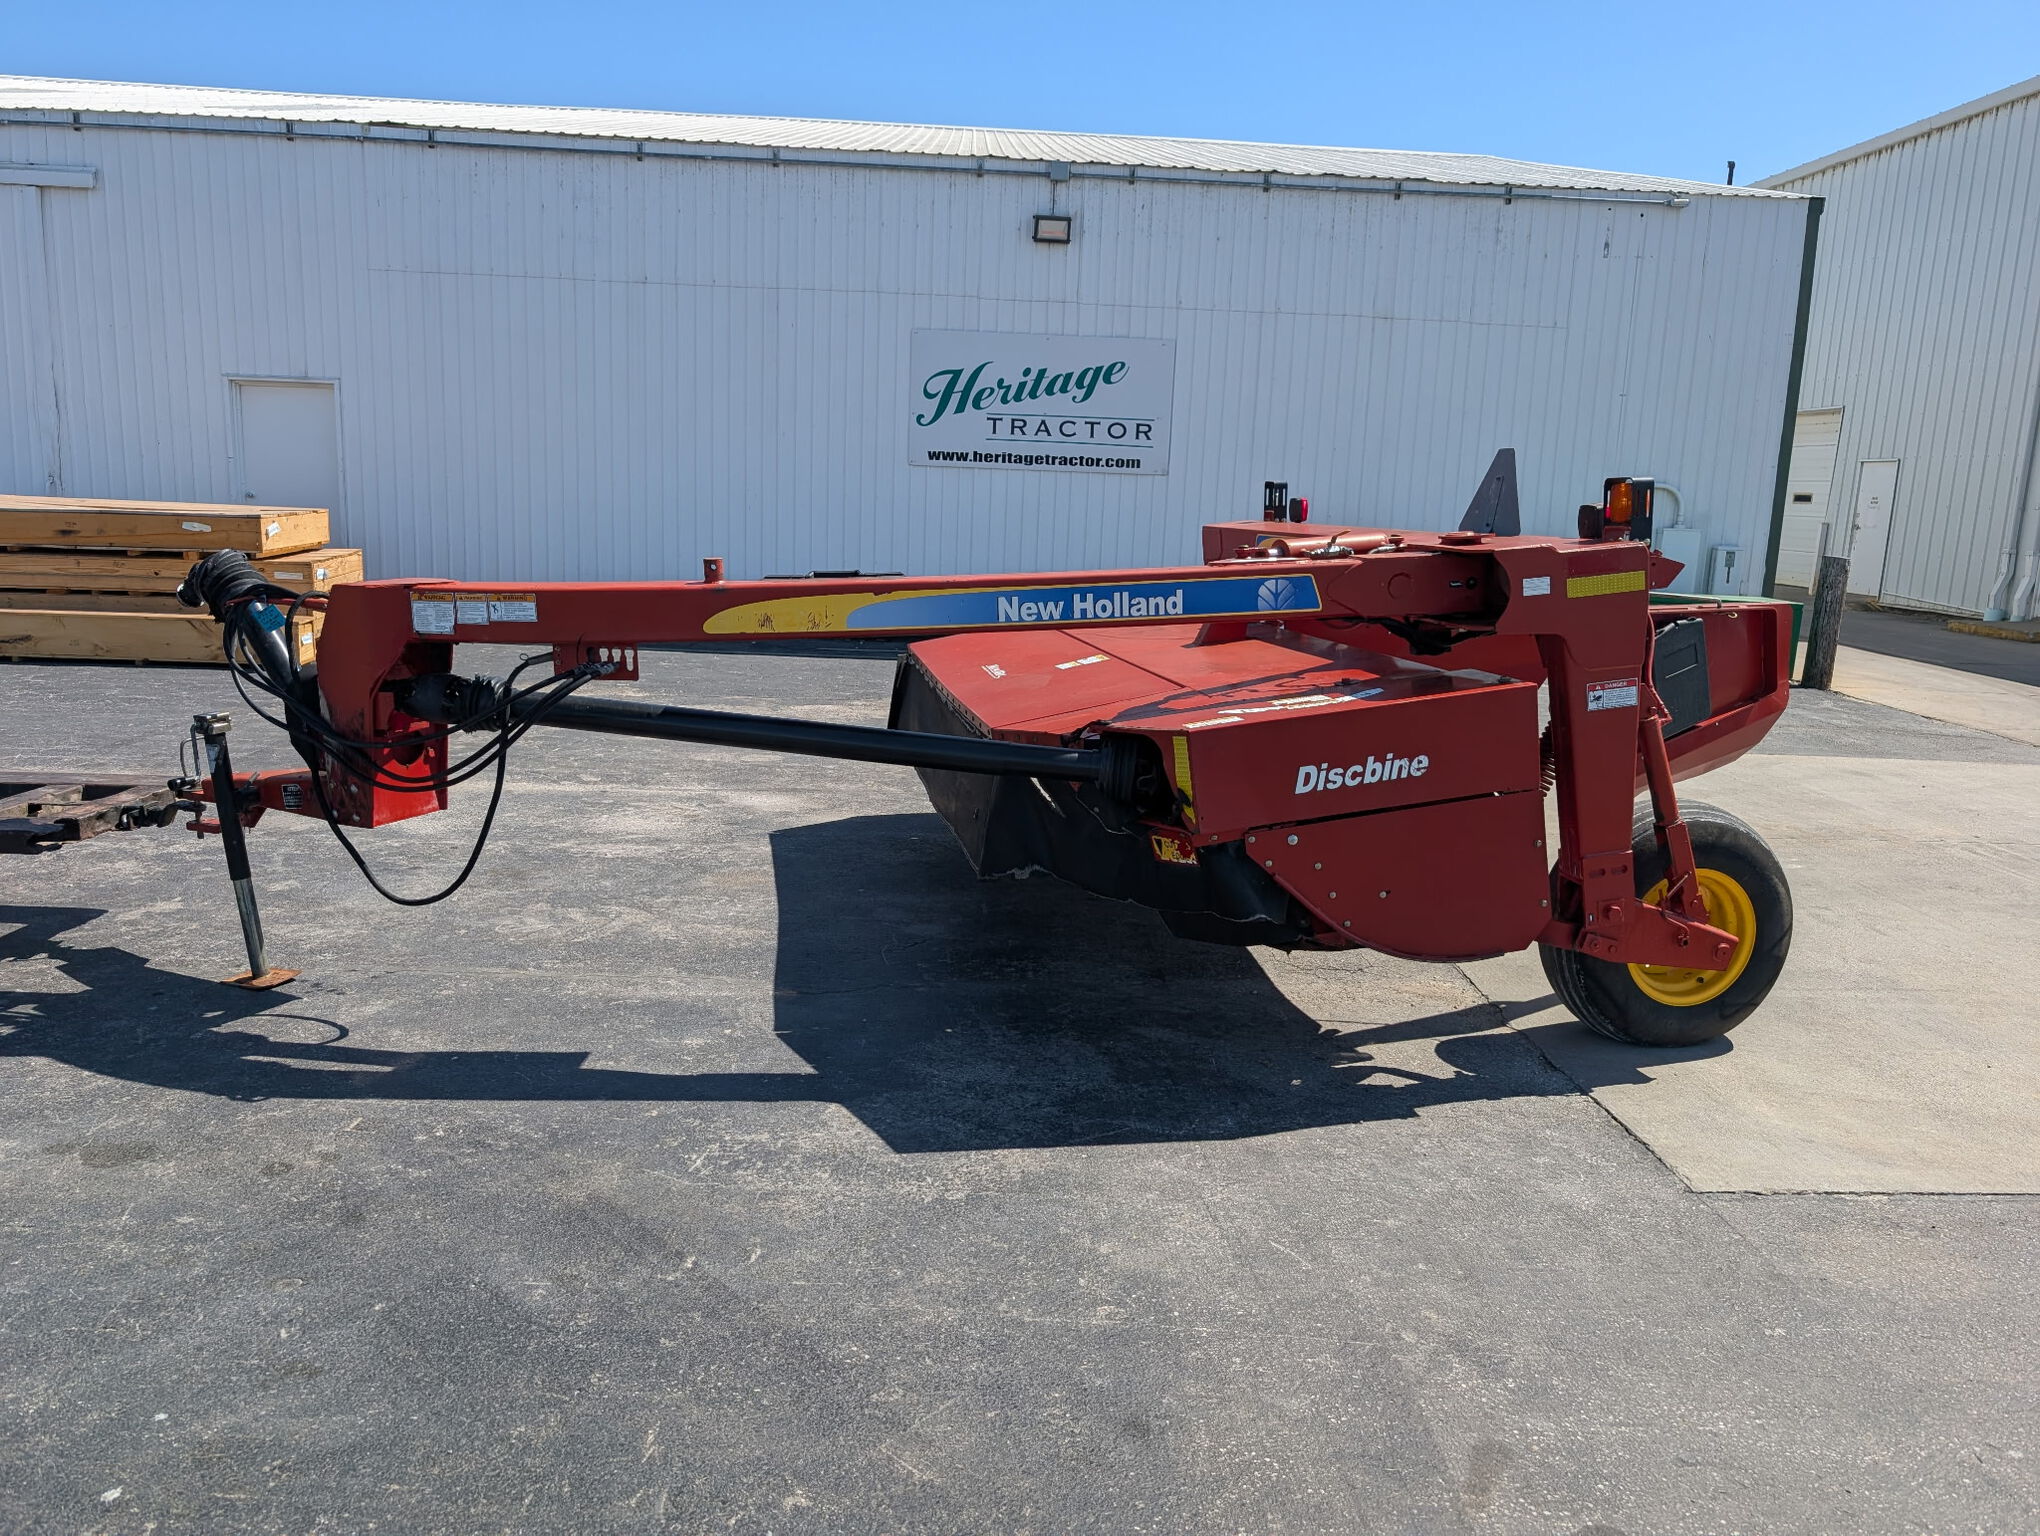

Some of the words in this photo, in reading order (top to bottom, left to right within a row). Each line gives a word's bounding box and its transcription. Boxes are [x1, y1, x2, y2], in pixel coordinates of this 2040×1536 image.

[916, 361, 1129, 426] Heritage
[987, 417, 1153, 440] TRACTOR
[927, 451, 1141, 469] www.heritagetractor.com
[998, 596, 1064, 622] New
[1073, 589, 1183, 618] Holland
[1295, 753, 1429, 795] Discbine
